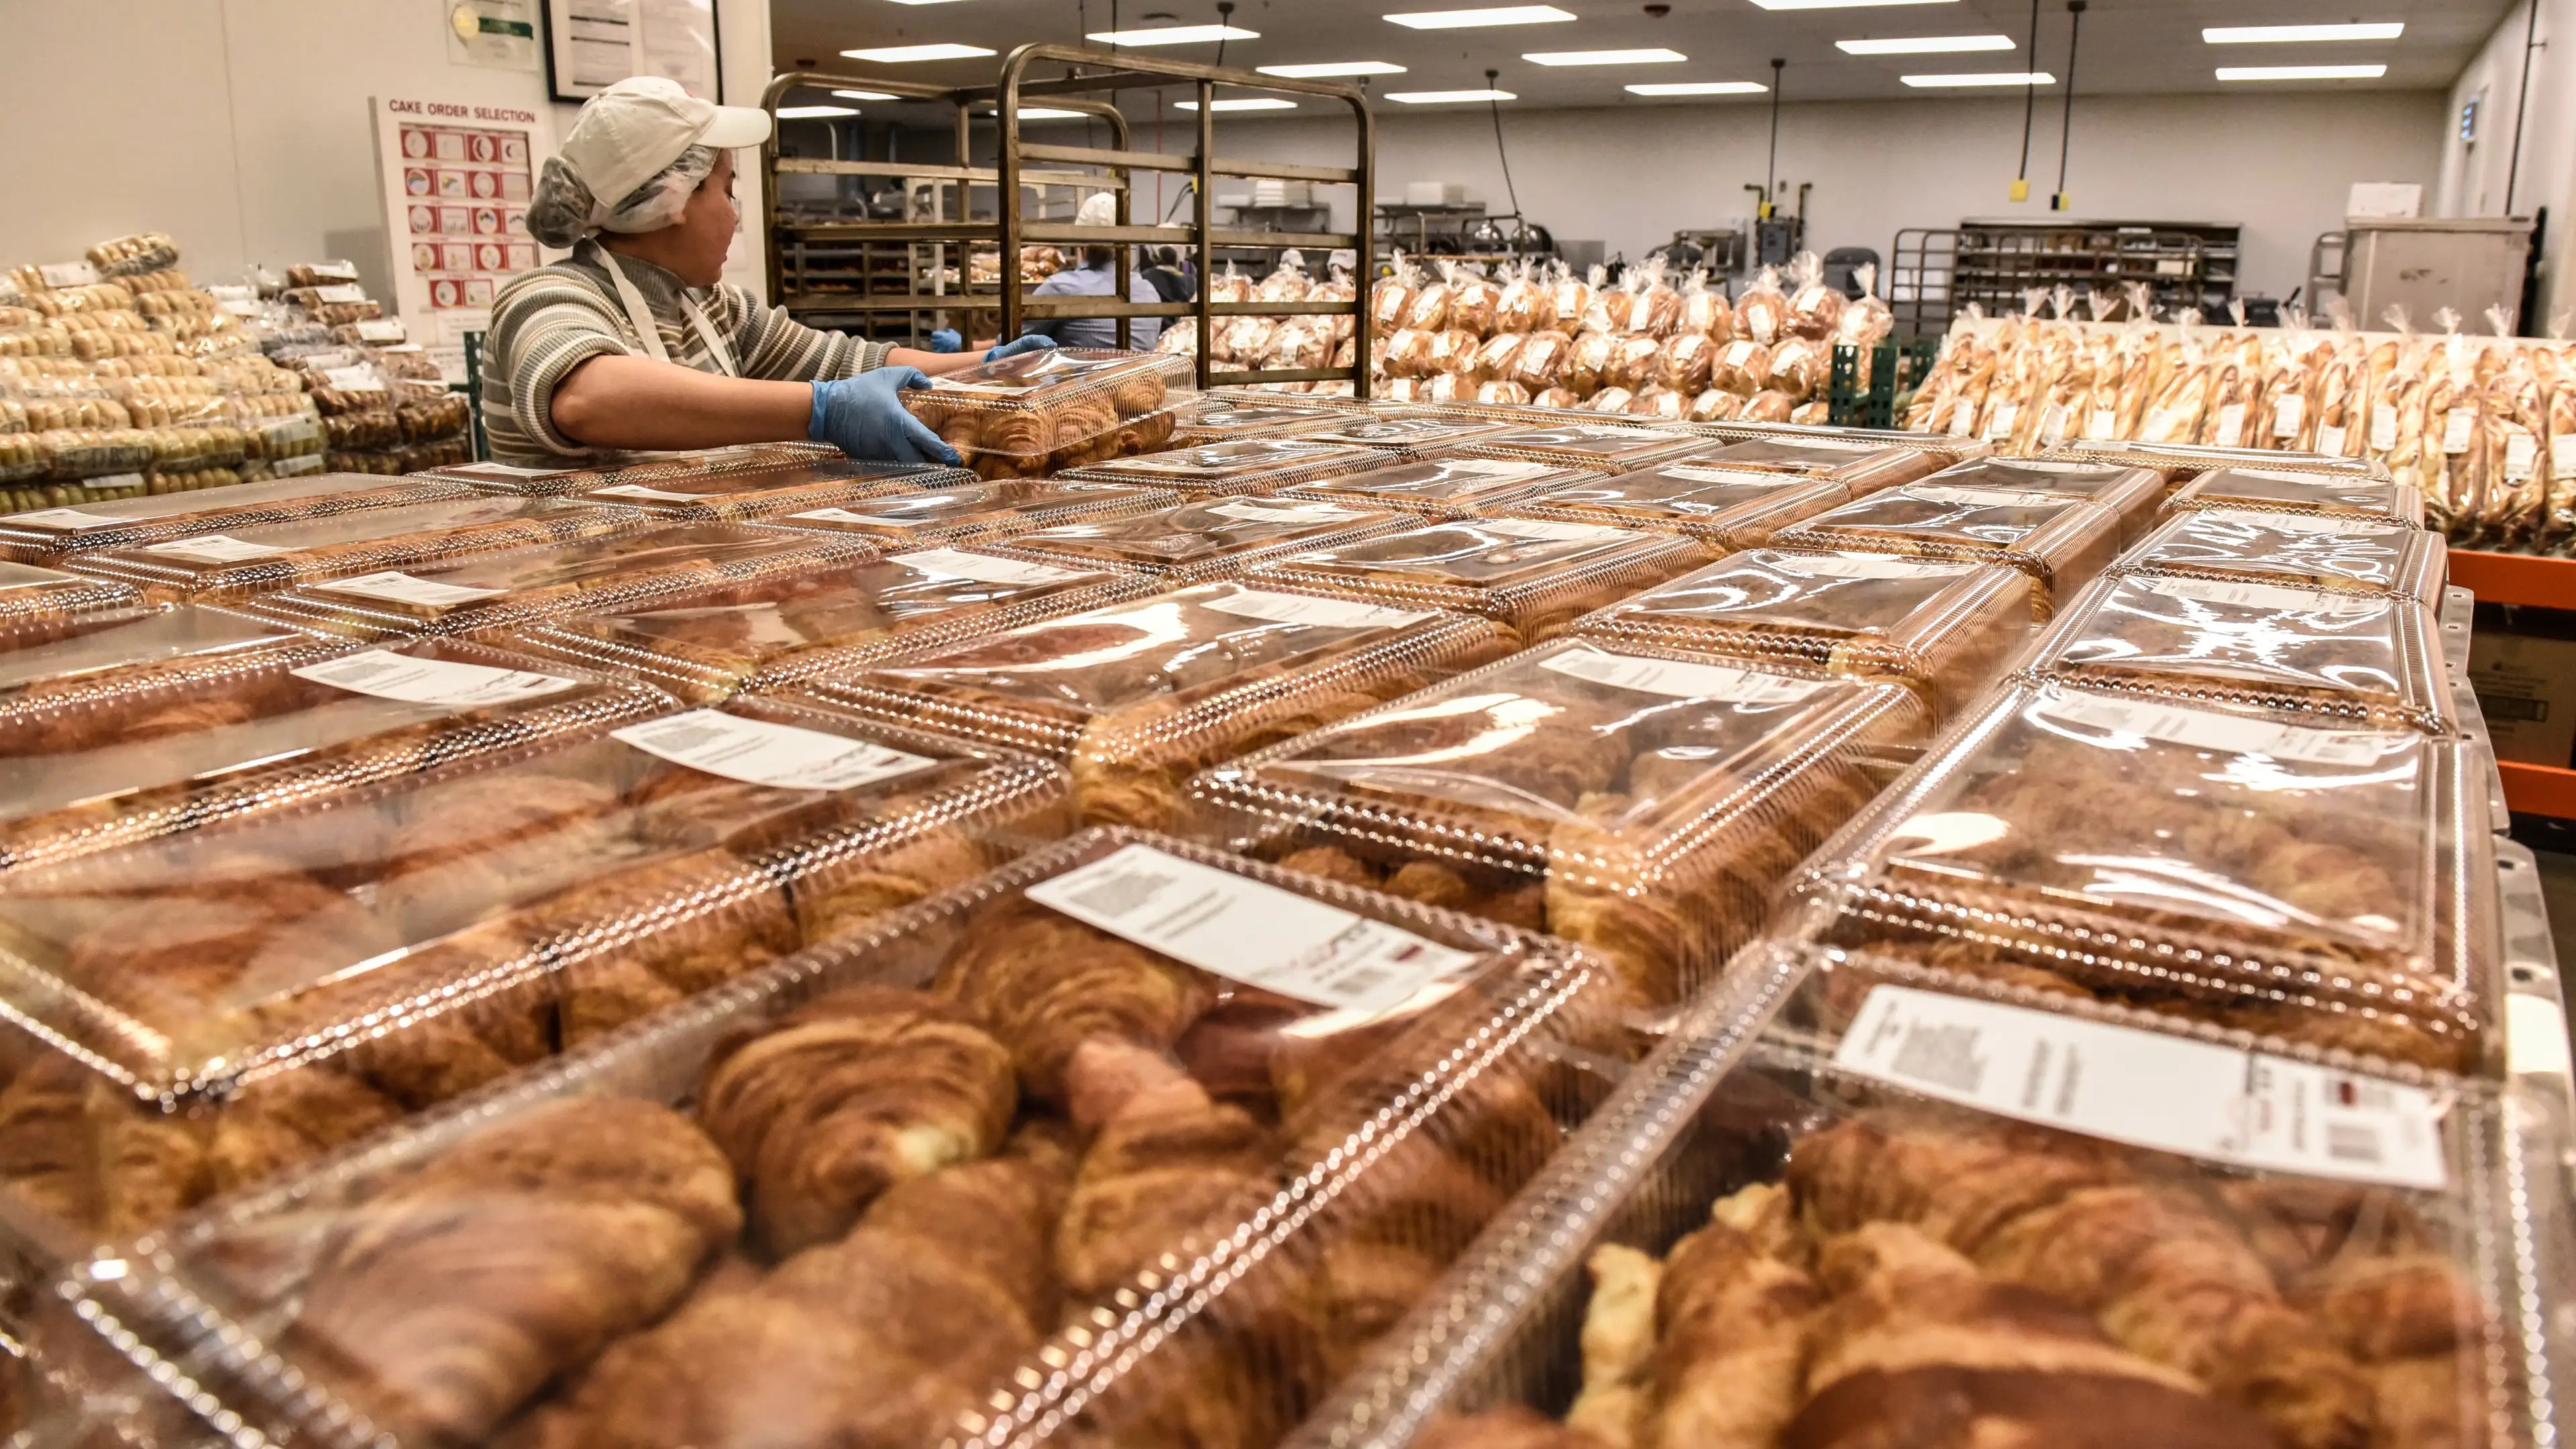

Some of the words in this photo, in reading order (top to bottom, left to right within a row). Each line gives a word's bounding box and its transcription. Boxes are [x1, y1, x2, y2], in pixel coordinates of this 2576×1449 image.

[389, 99, 422, 114] CAKE
[427, 103, 468, 117] ORDER
[474, 107, 535, 123] SELECTION
